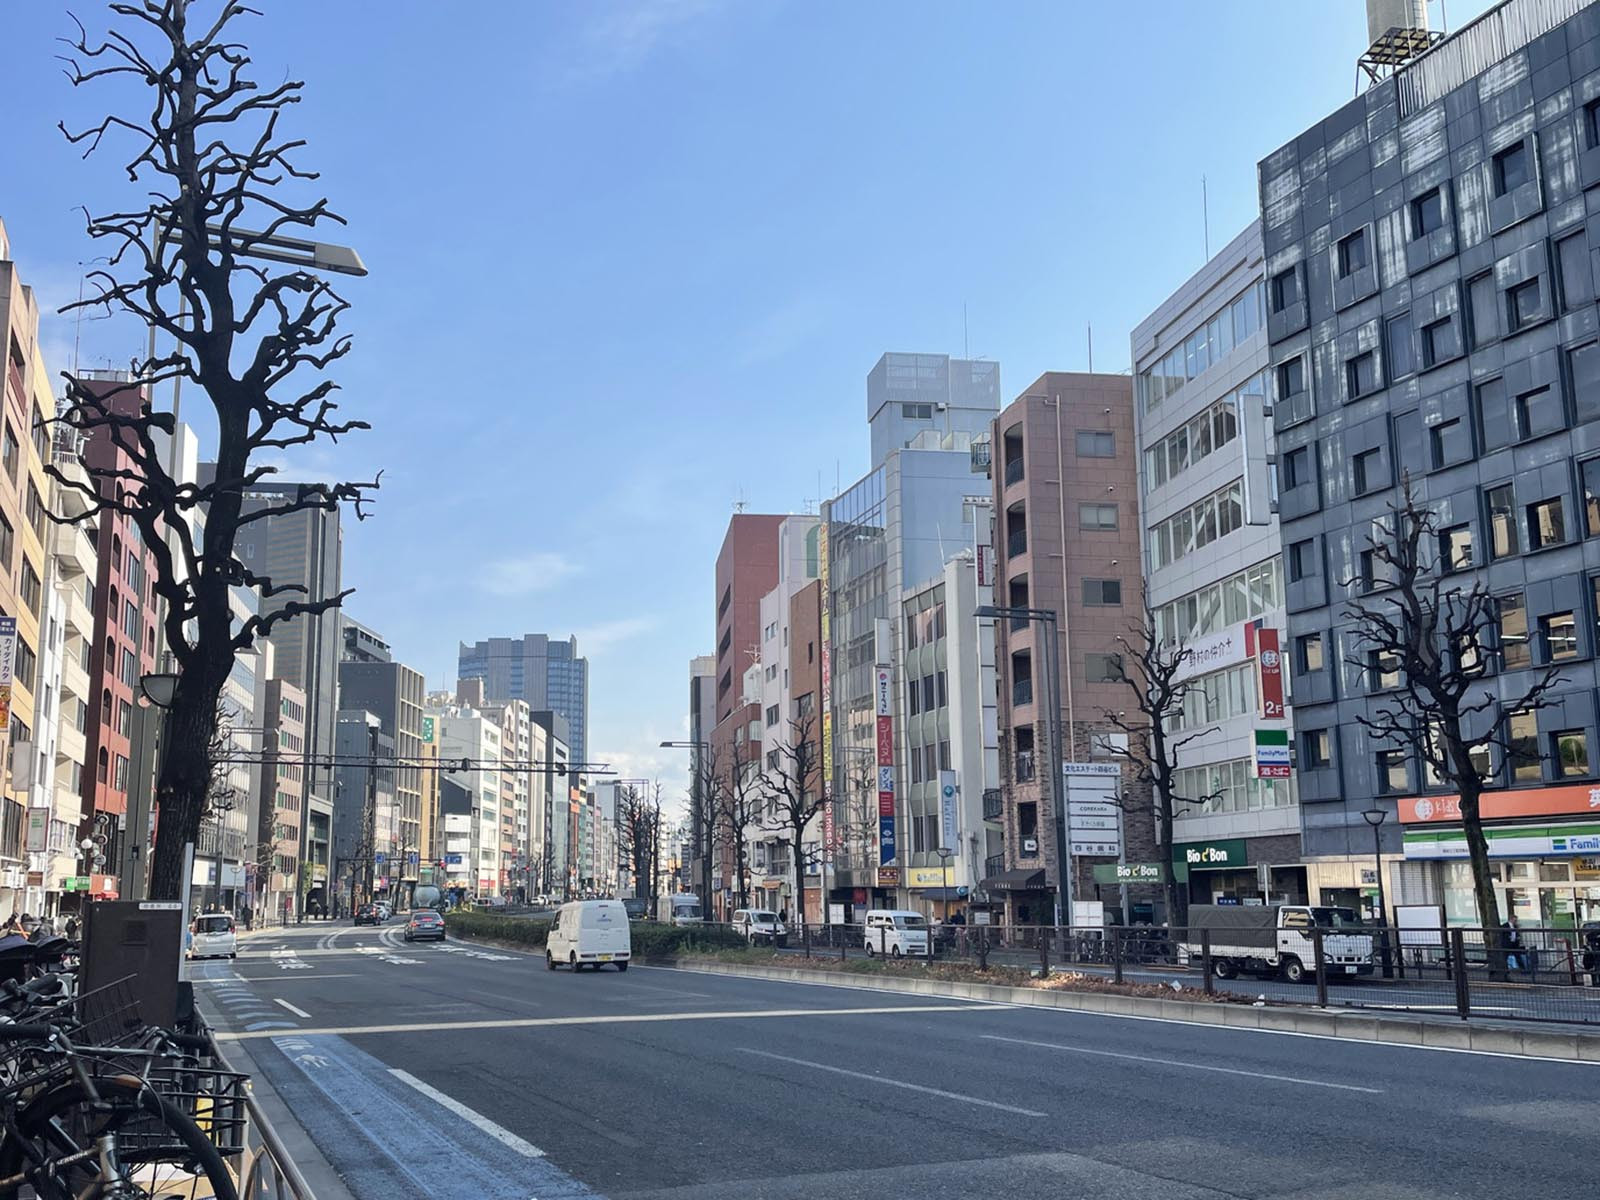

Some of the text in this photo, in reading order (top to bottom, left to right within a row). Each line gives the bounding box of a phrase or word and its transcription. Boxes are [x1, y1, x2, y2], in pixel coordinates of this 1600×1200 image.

[1266, 701, 1282, 714] 2F
[1570, 838, 1600, 849] Famil
[1186, 849, 1200, 863] Bio
[1209, 850, 1227, 862] Bon
[1117, 865, 1131, 877] Bio
[1141, 866, 1158, 876] Bon
